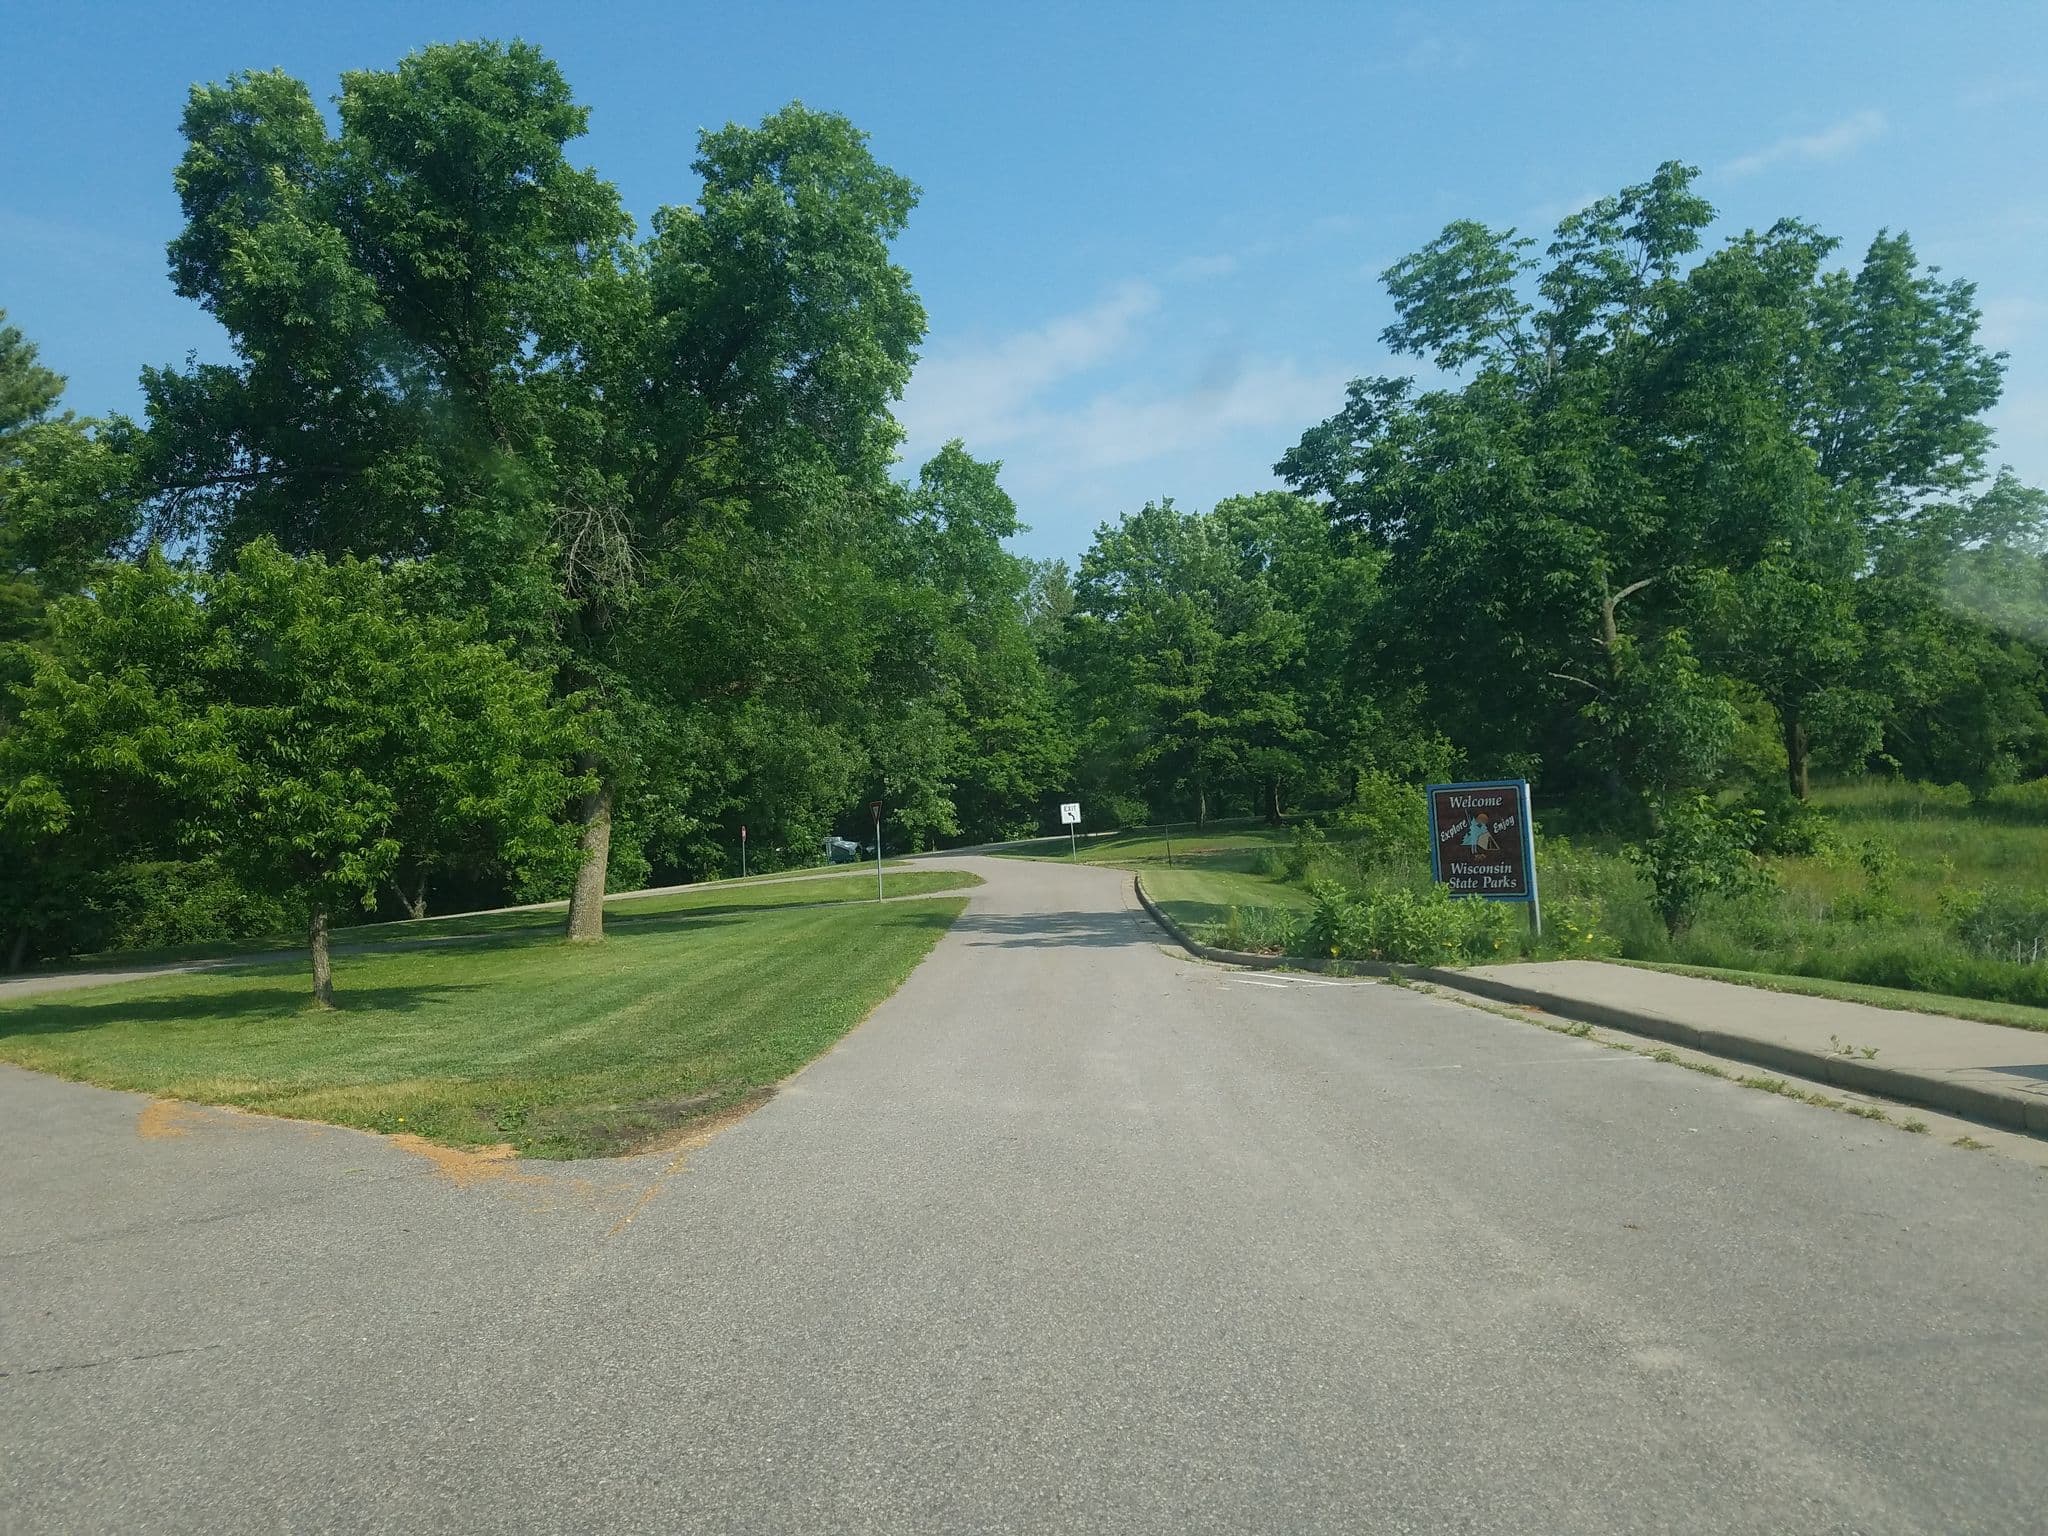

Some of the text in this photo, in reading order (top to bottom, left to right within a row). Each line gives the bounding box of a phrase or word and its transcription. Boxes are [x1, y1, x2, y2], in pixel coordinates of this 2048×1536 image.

[1449, 795, 1502, 808] Welcome
[1440, 819, 1468, 842] Explore
[1493, 815, 1515, 834] Enjoy
[1450, 861, 1512, 874] Wisconsin
[1449, 876, 1517, 889] State Parks
